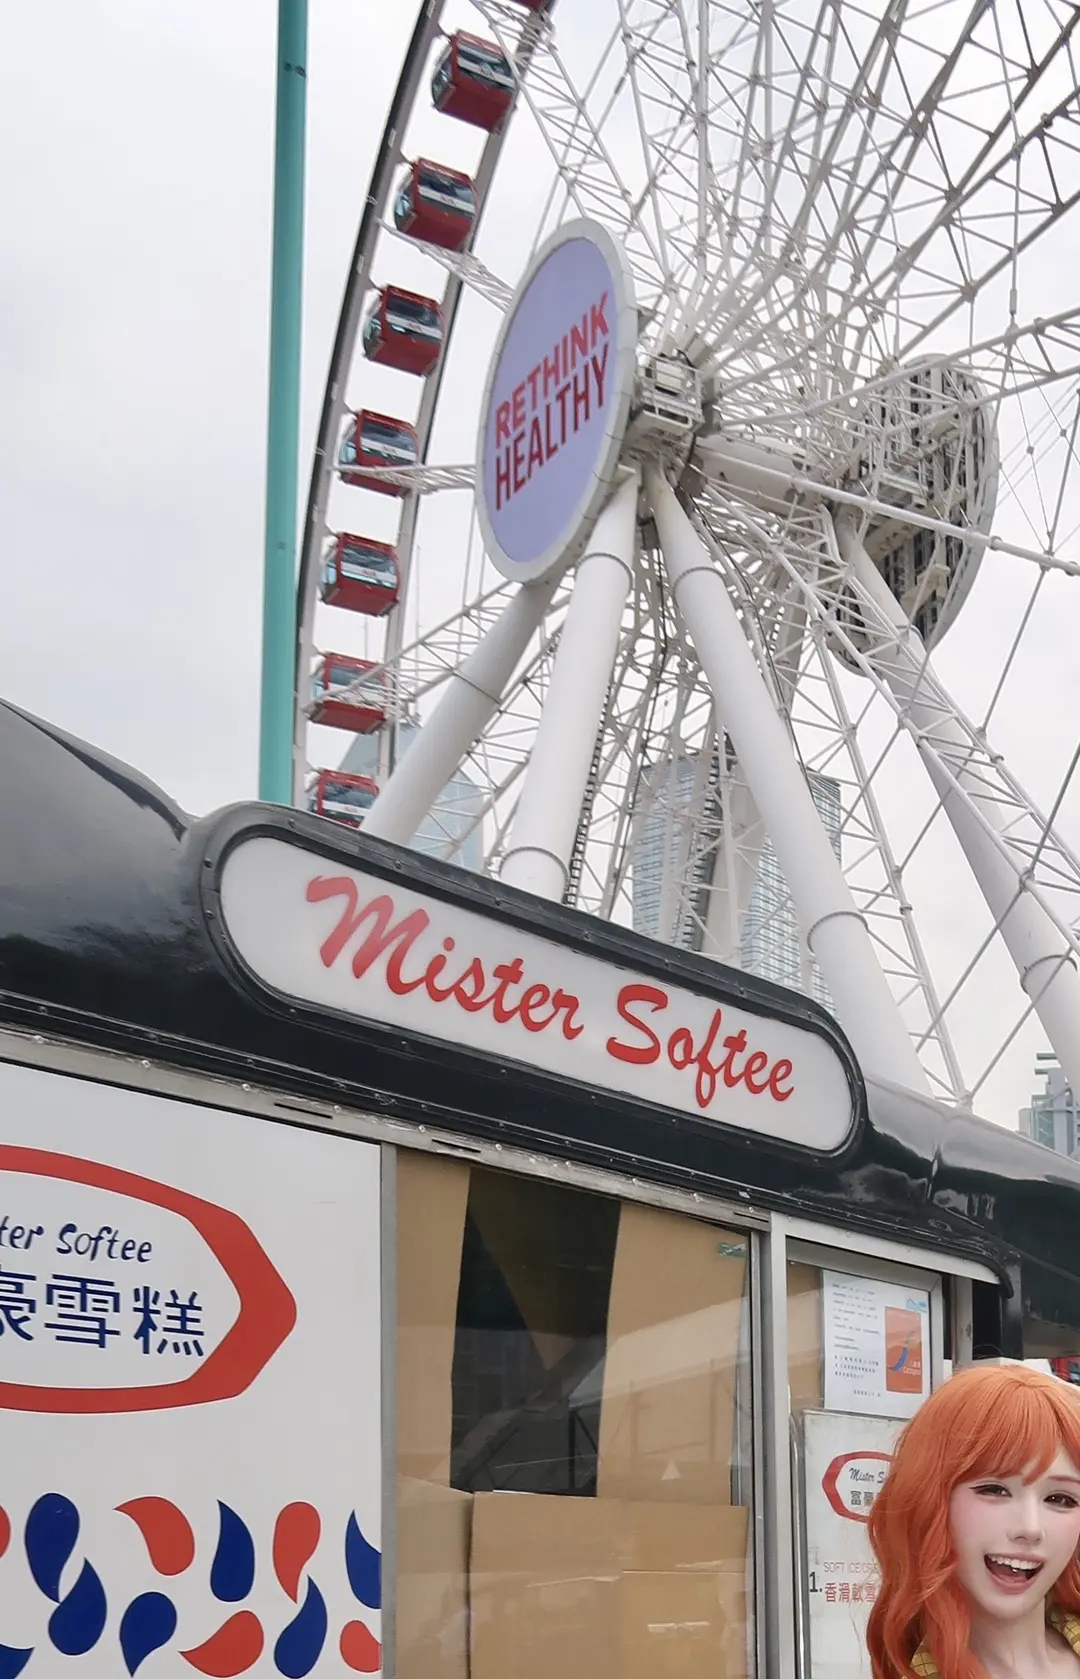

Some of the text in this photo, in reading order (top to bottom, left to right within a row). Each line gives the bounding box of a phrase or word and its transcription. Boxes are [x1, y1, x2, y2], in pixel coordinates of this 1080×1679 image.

[495, 291, 610, 449] RETHINK
[496, 342, 609, 511] HEALTHY
[306, 875, 795, 1108] Mister Softee
[56, 1222, 152, 1262] Softee
